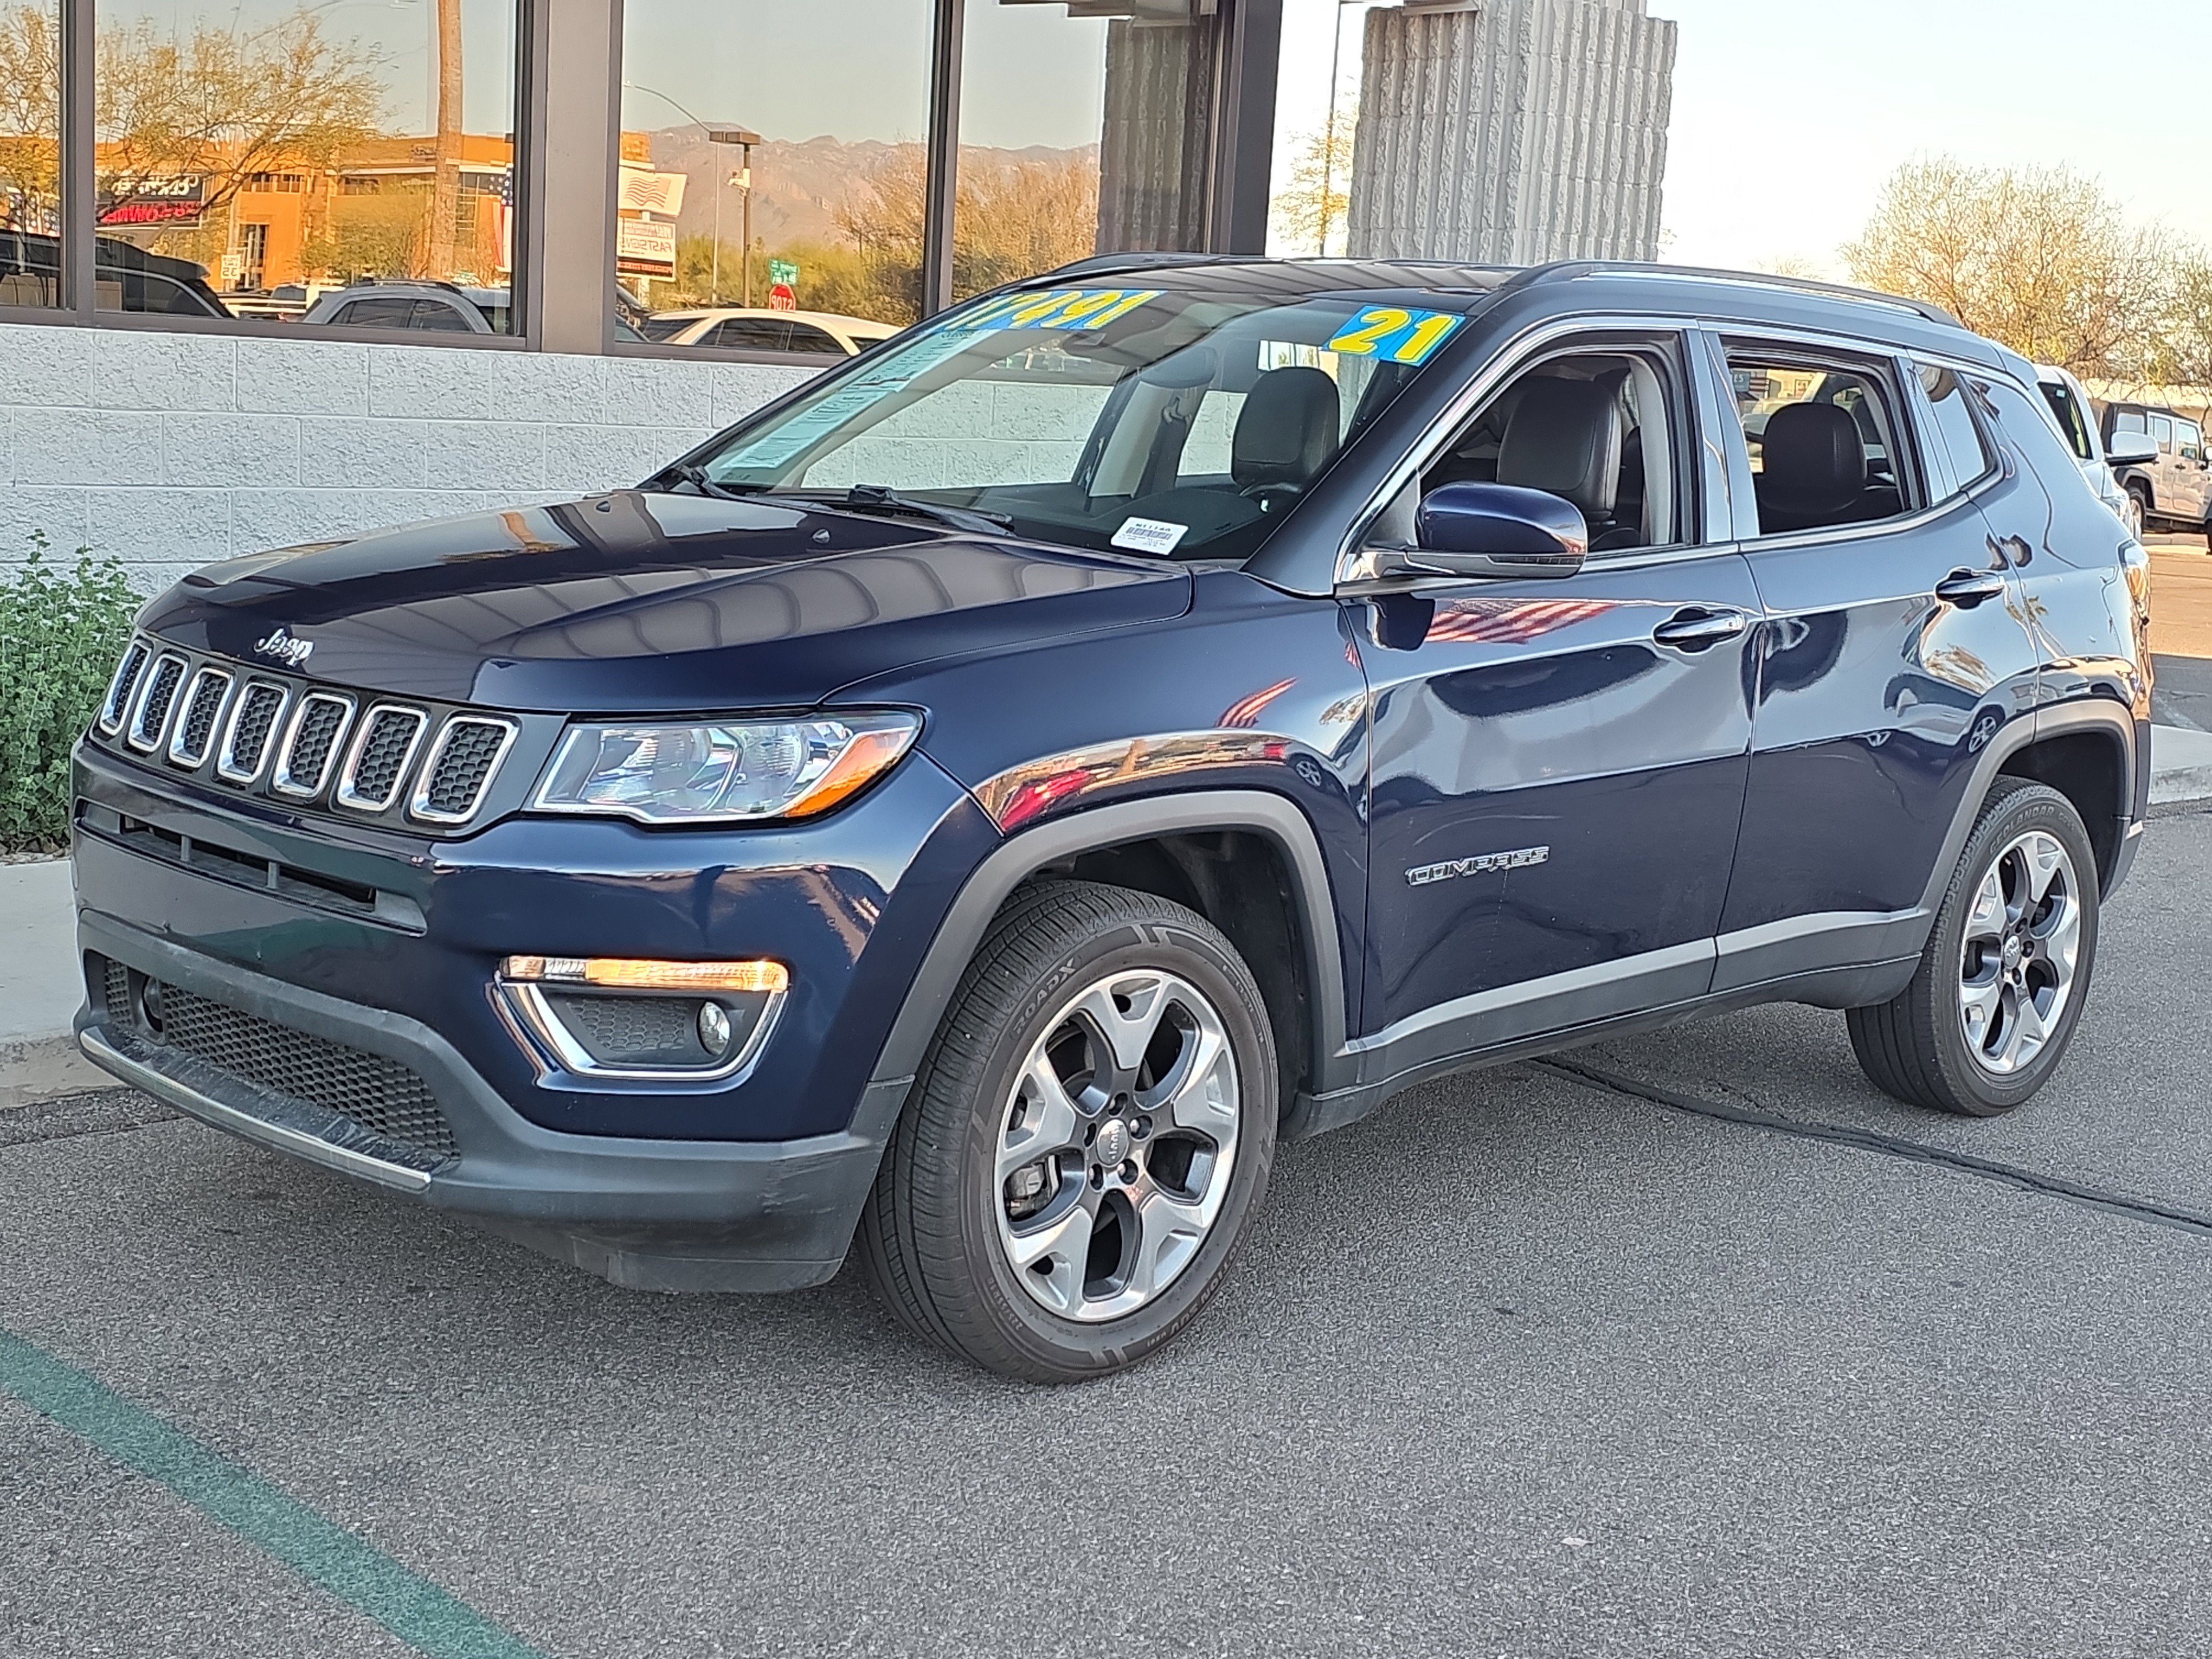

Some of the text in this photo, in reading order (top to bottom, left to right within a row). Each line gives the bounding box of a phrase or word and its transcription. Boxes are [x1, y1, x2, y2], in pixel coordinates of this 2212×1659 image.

[1329, 310, 1457, 363] 21
[254, 628, 314, 667] Jeep
[1404, 846, 1549, 886] COMPASS
[1013, 959, 1077, 1033] ROADX
